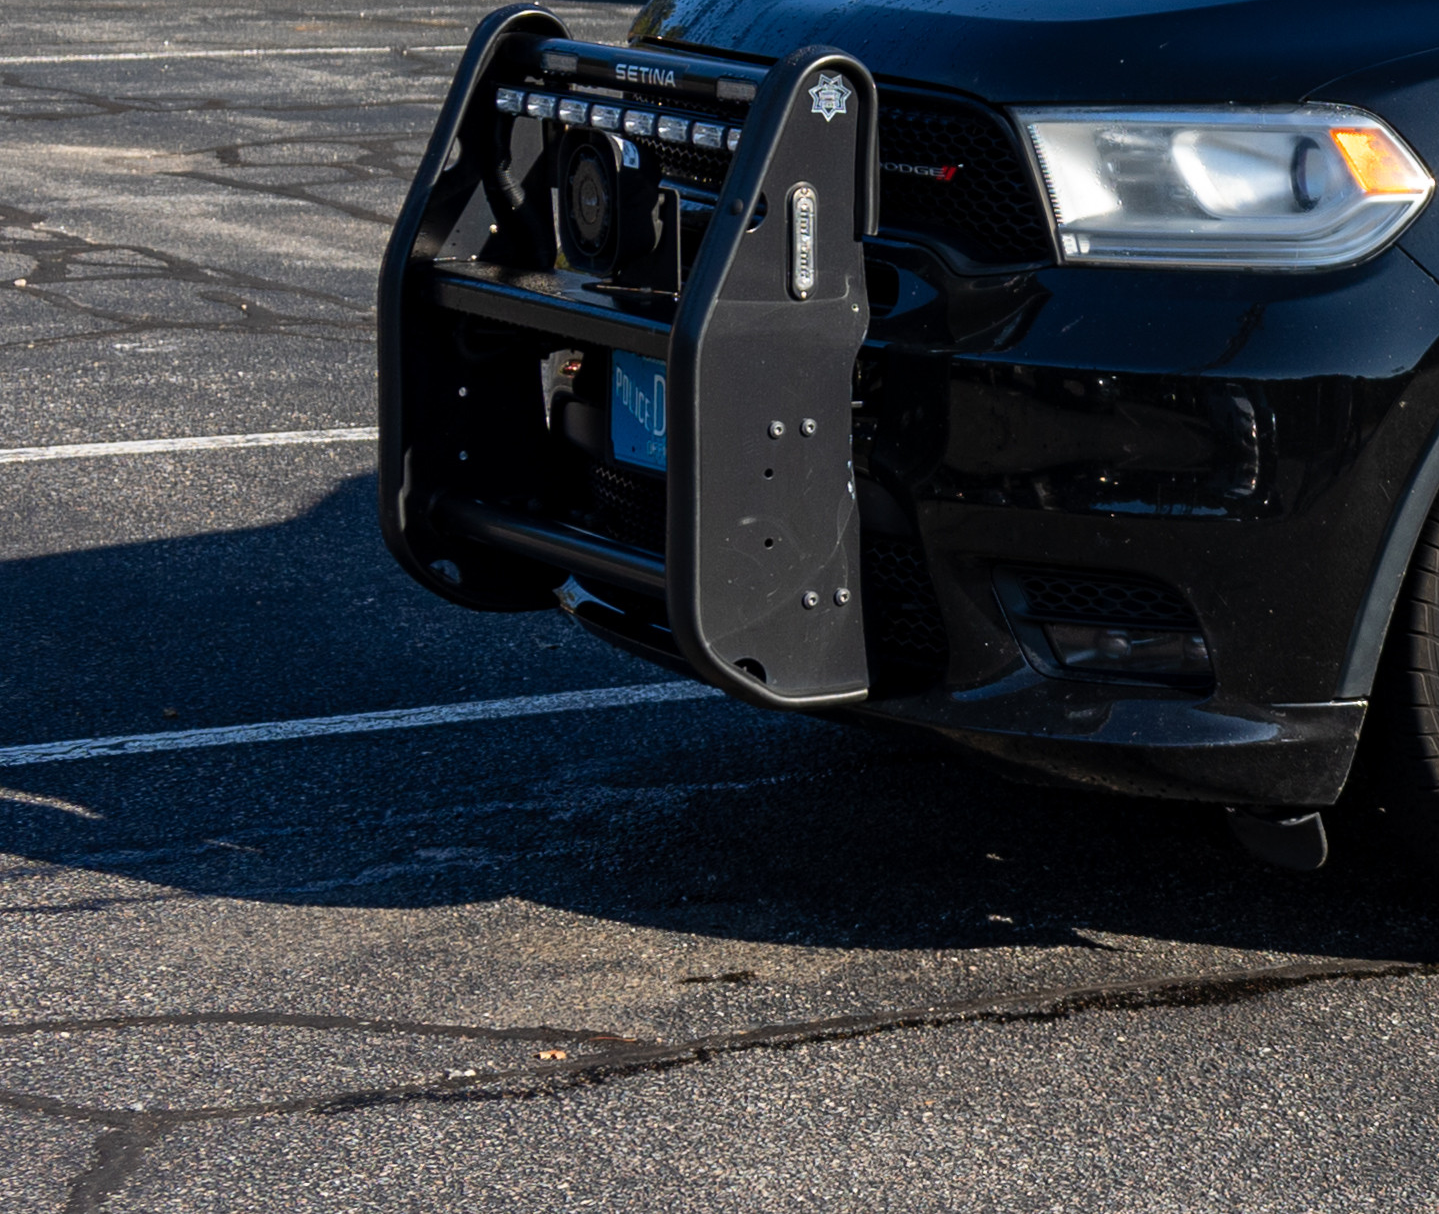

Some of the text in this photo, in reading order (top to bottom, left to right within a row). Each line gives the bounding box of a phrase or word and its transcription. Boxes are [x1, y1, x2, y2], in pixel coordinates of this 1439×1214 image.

[615, 63, 676, 88] SETINA
[880, 161, 945, 178] ODGE
[616, 366, 651, 432] POLICE
